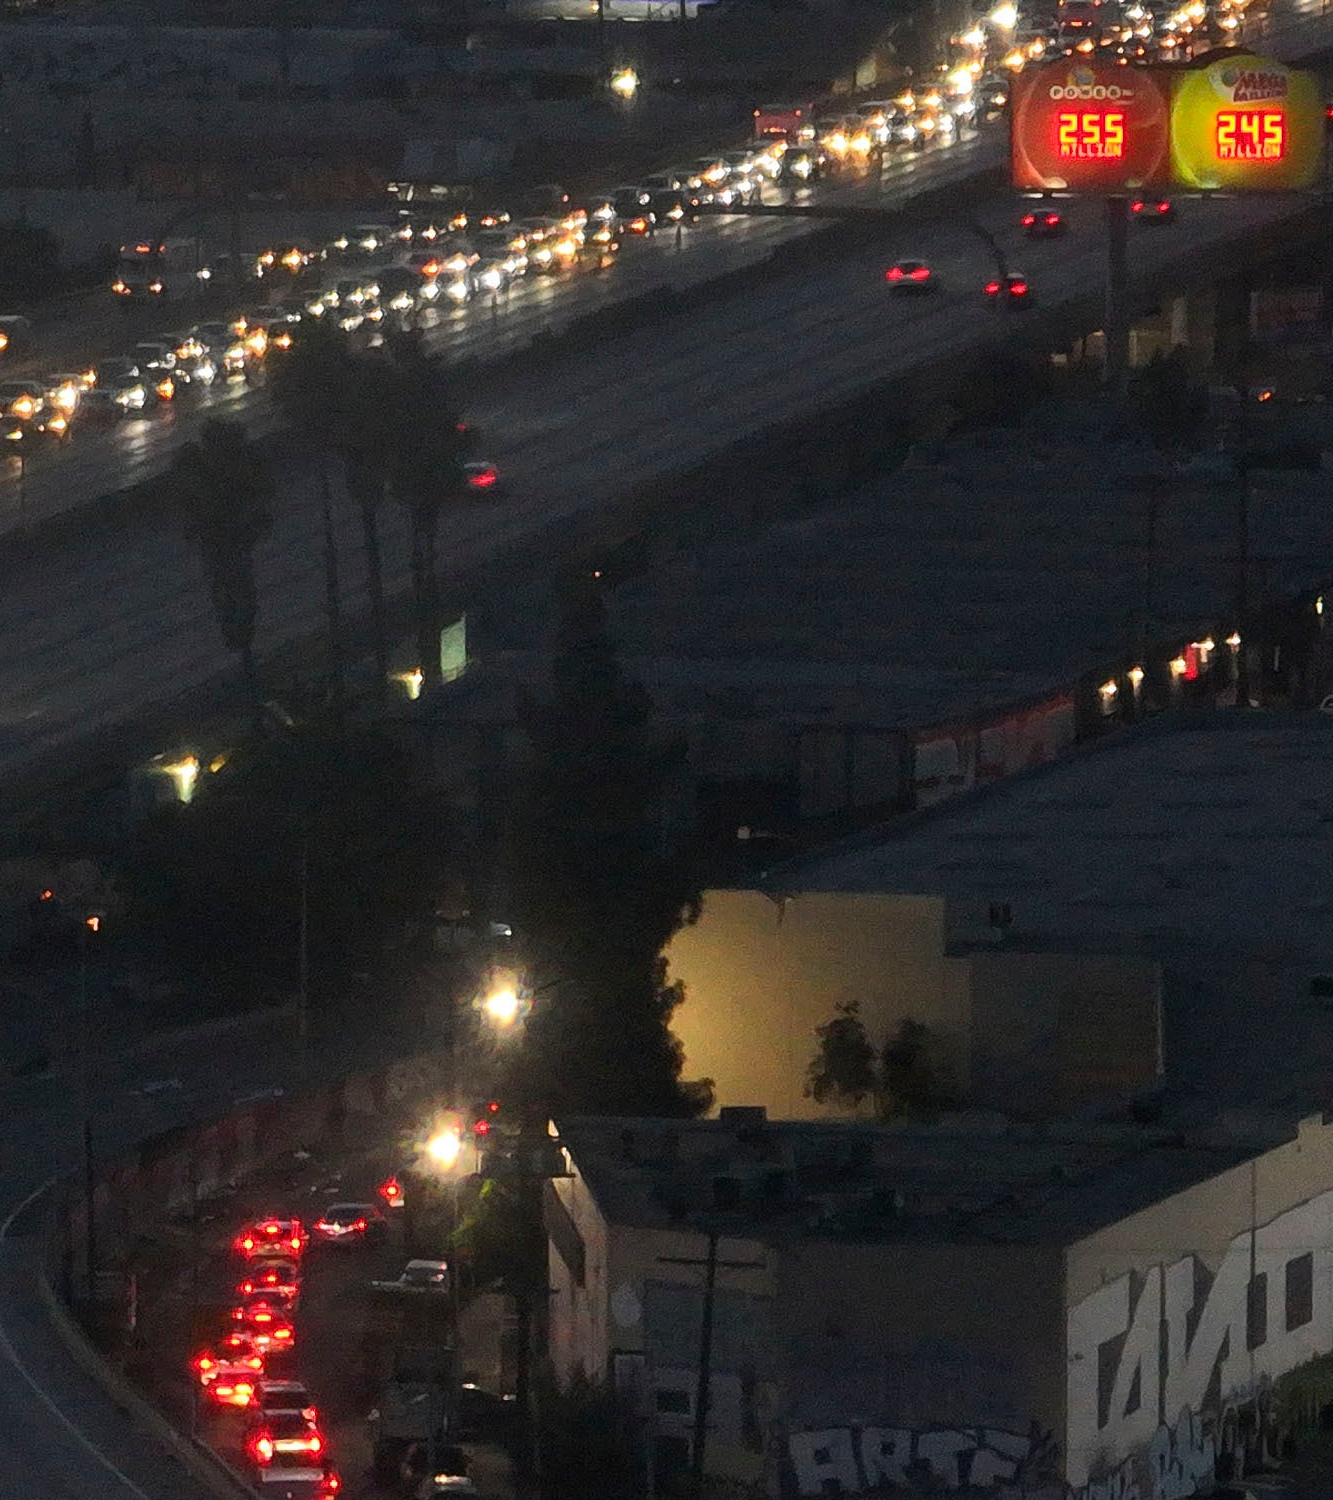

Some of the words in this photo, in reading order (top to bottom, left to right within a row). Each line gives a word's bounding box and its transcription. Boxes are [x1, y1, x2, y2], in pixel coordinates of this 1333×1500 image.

[1060, 114, 1123, 143] 255
[1218, 114, 1282, 144] 245
[1061, 143, 1123, 158] MILLION
[1219, 143, 1281, 158] MILLION
